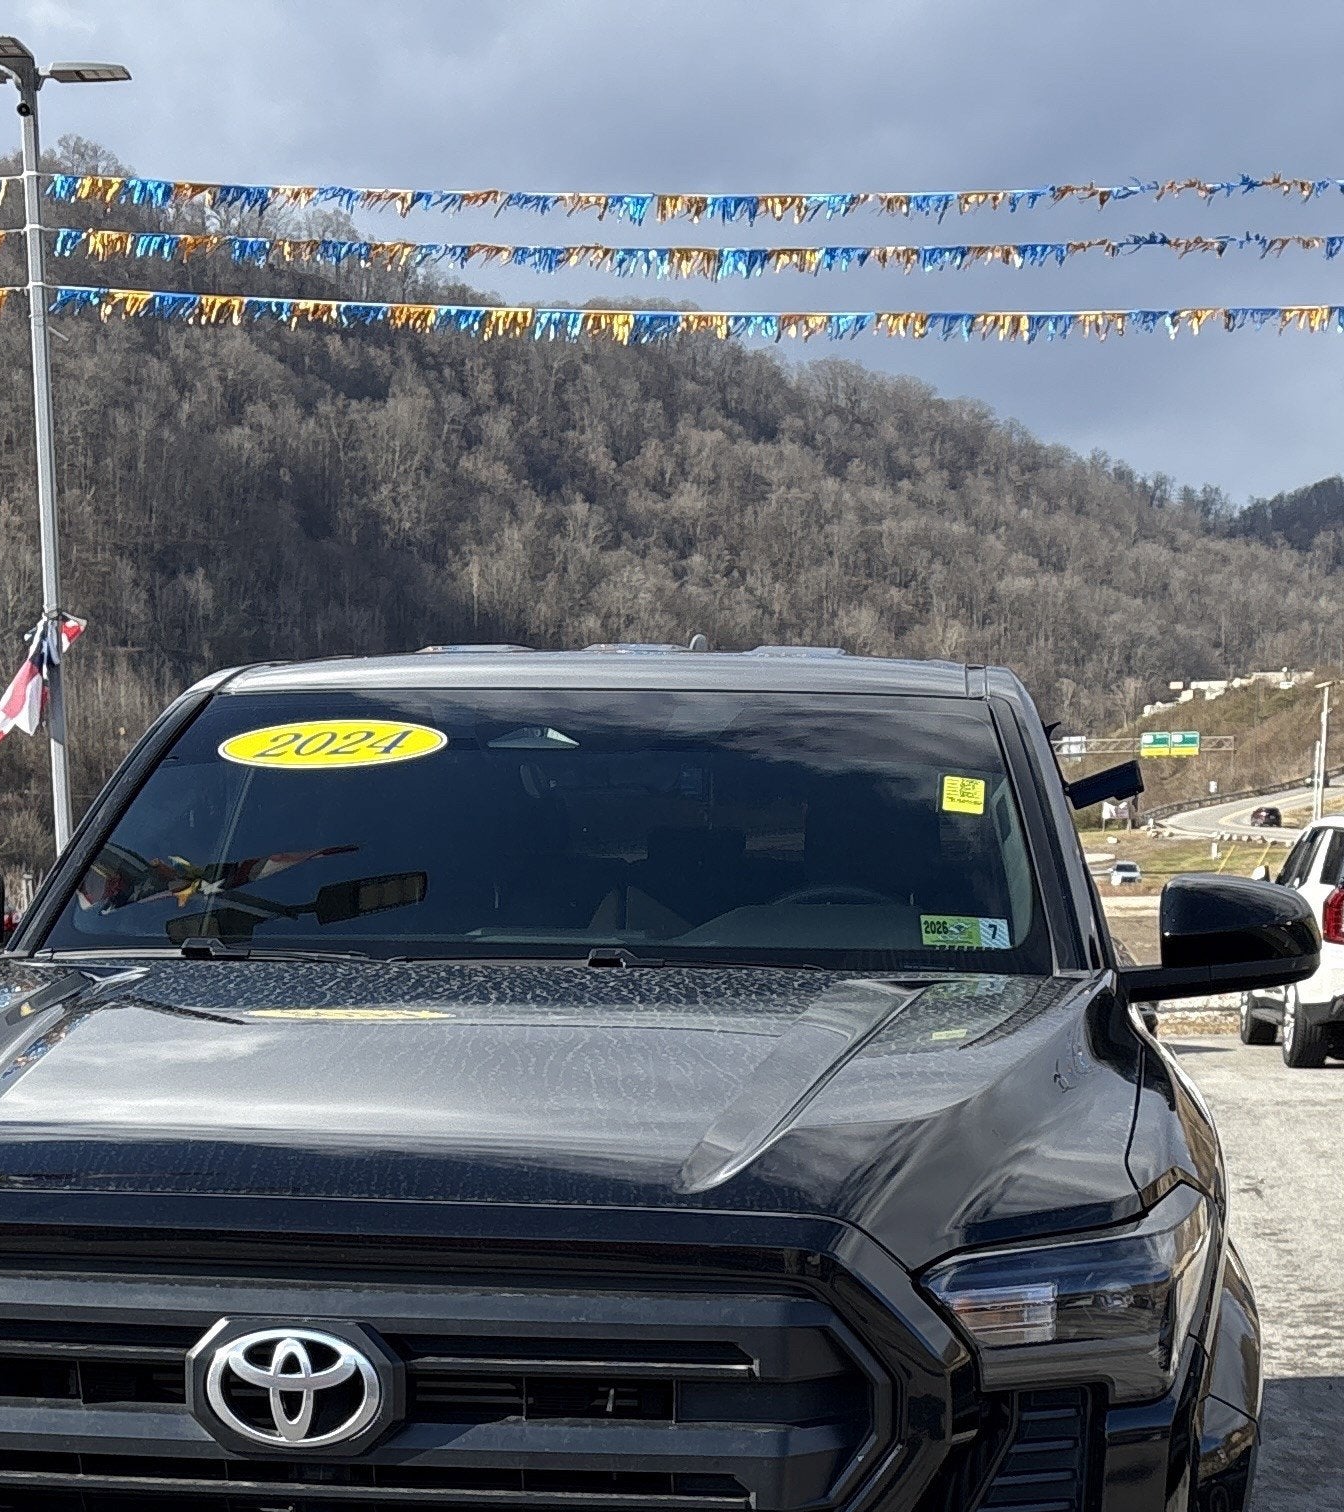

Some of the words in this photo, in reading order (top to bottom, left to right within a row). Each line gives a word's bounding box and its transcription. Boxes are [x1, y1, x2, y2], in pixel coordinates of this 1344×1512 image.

[252, 729, 414, 759] 2024
[922, 920, 949, 935] 2026
[988, 923, 998, 940] 7
